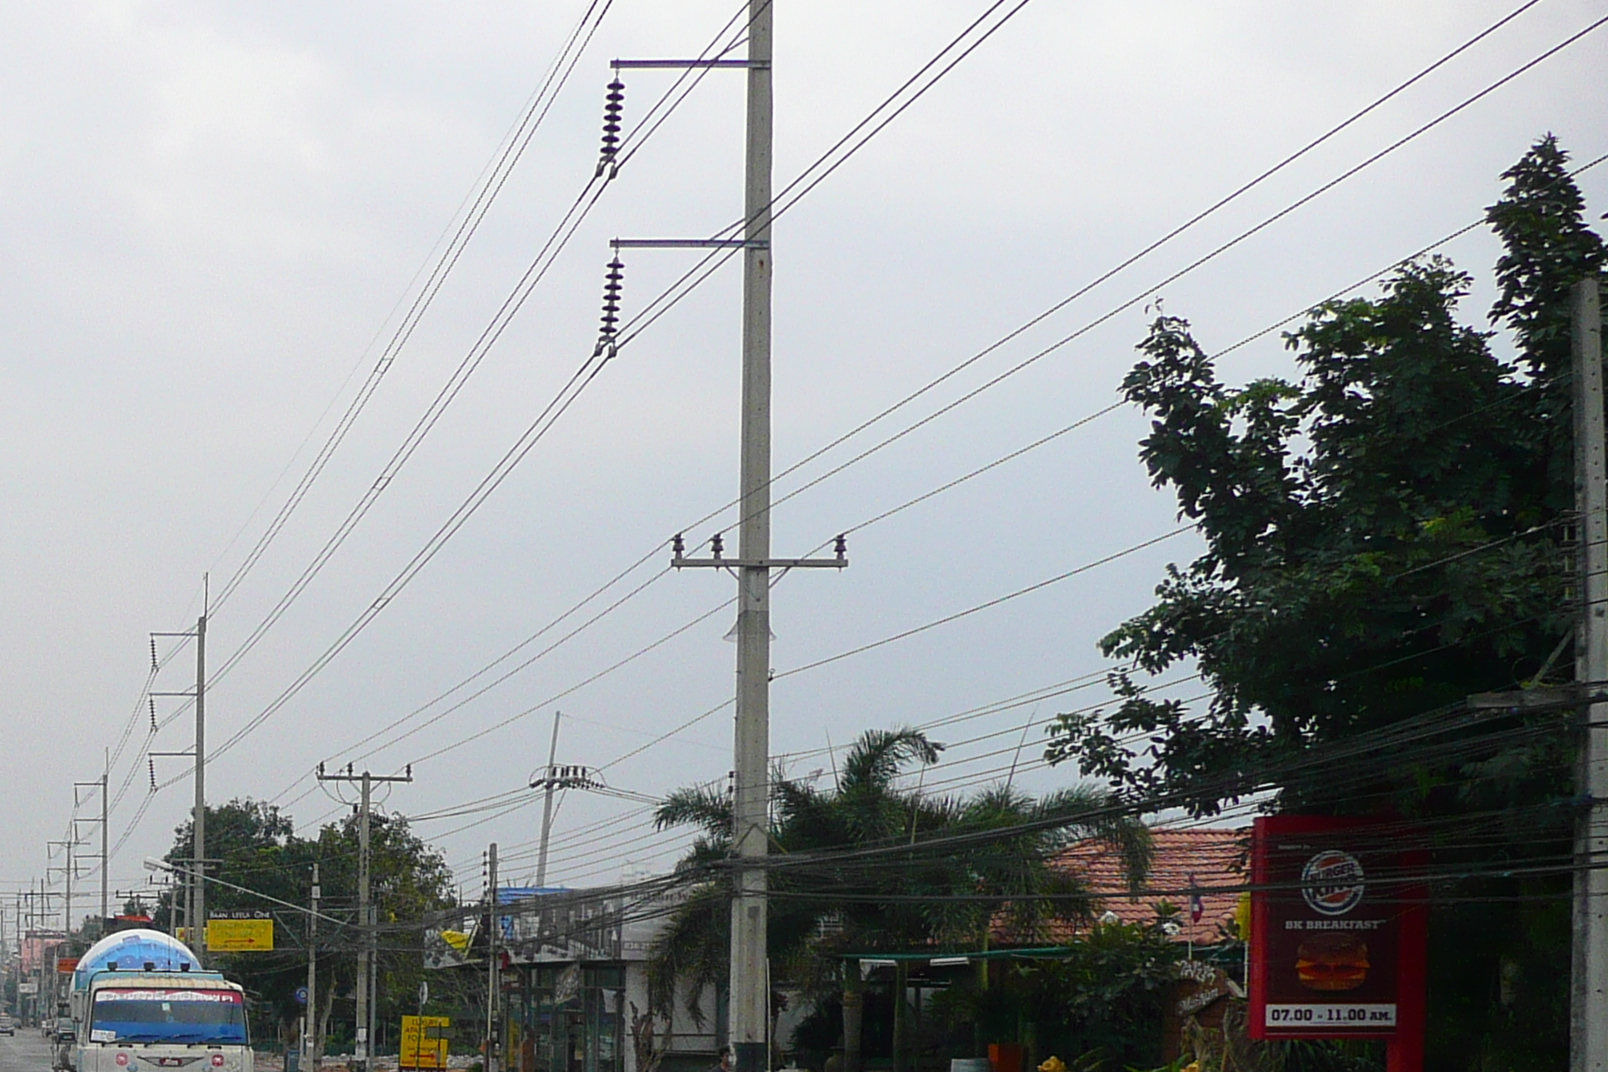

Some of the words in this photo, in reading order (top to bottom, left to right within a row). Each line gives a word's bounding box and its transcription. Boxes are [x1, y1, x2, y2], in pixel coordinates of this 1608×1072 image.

[1309, 861, 1357, 881] BURGER
[209, 910, 228, 919] BAAN
[1285, 920, 1303, 930] BK
[1306, 920, 1379, 930] BREAKFAST
[1271, 1009, 1313, 1022] 07.00
[1327, 1009, 1367, 1022] 11.00
